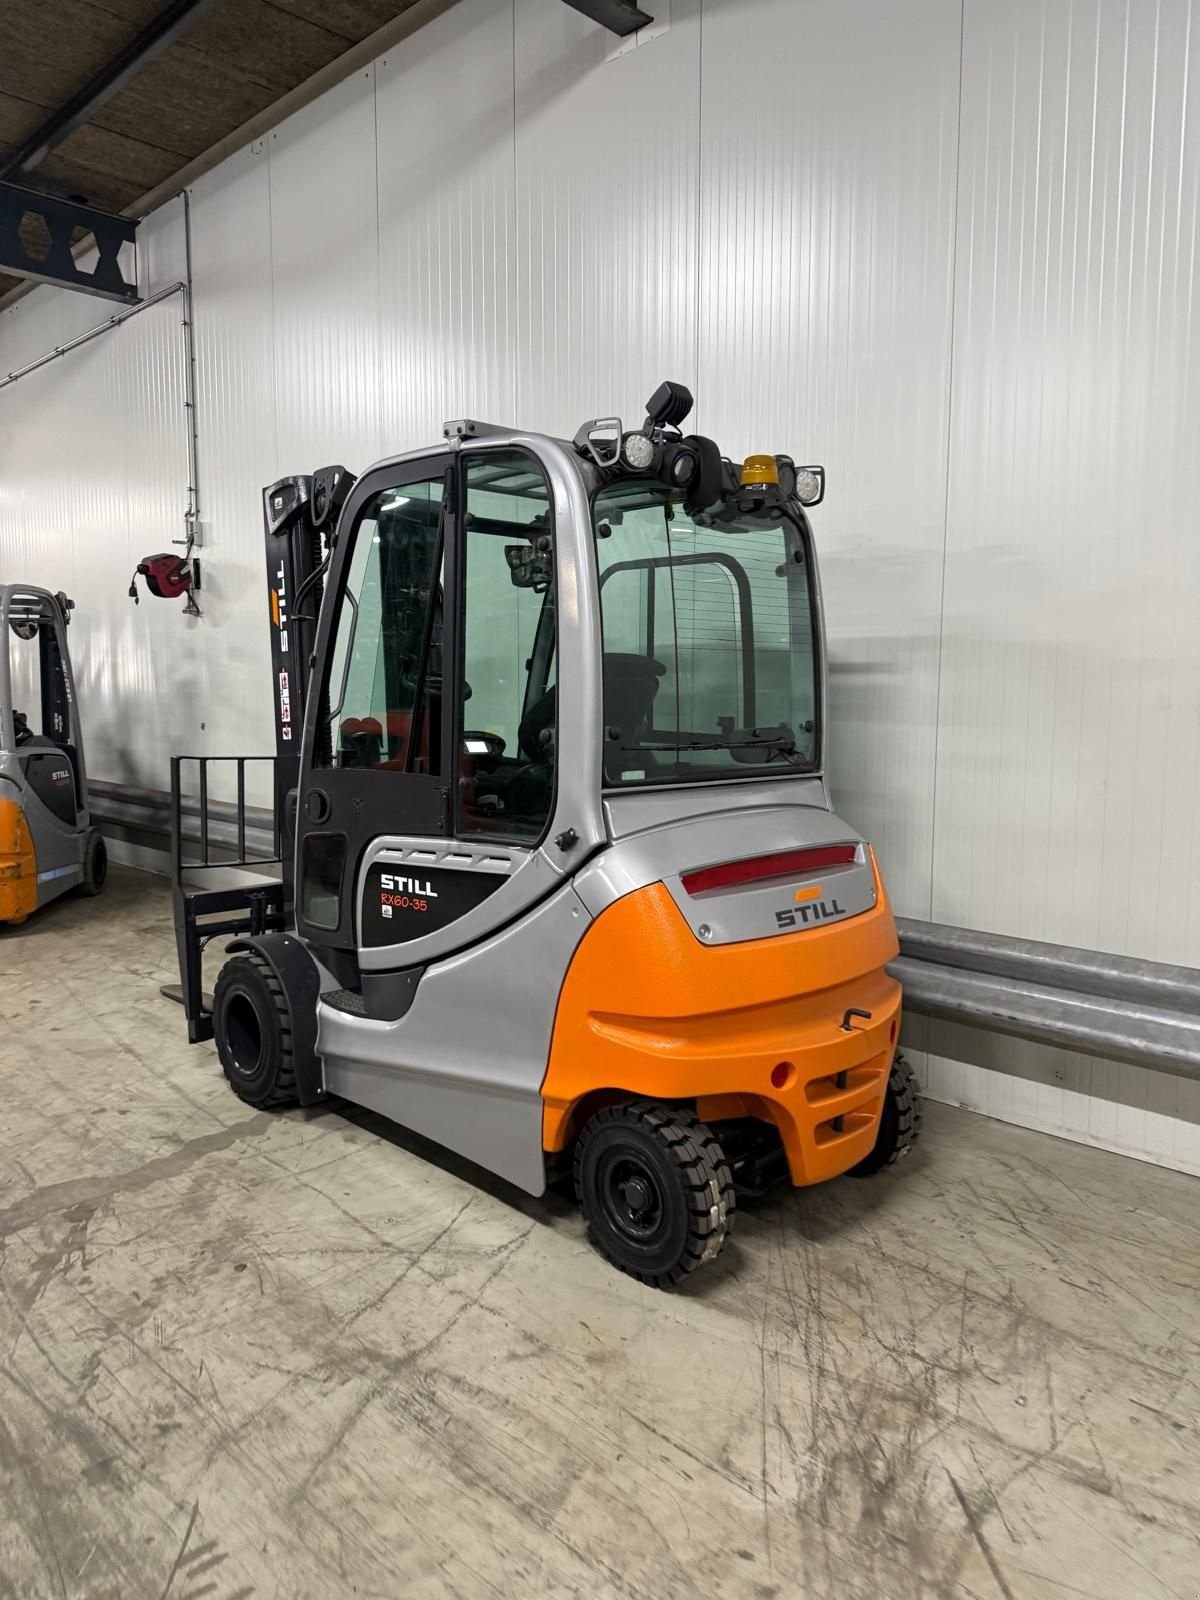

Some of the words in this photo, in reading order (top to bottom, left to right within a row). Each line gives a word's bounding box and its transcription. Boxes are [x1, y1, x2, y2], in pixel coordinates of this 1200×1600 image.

[277, 560, 289, 652] STILL
[52, 769, 70, 780] STILL
[381, 873, 438, 897] STILL
[381, 893, 428, 912] RX60-35
[775, 899, 846, 929] STILL
